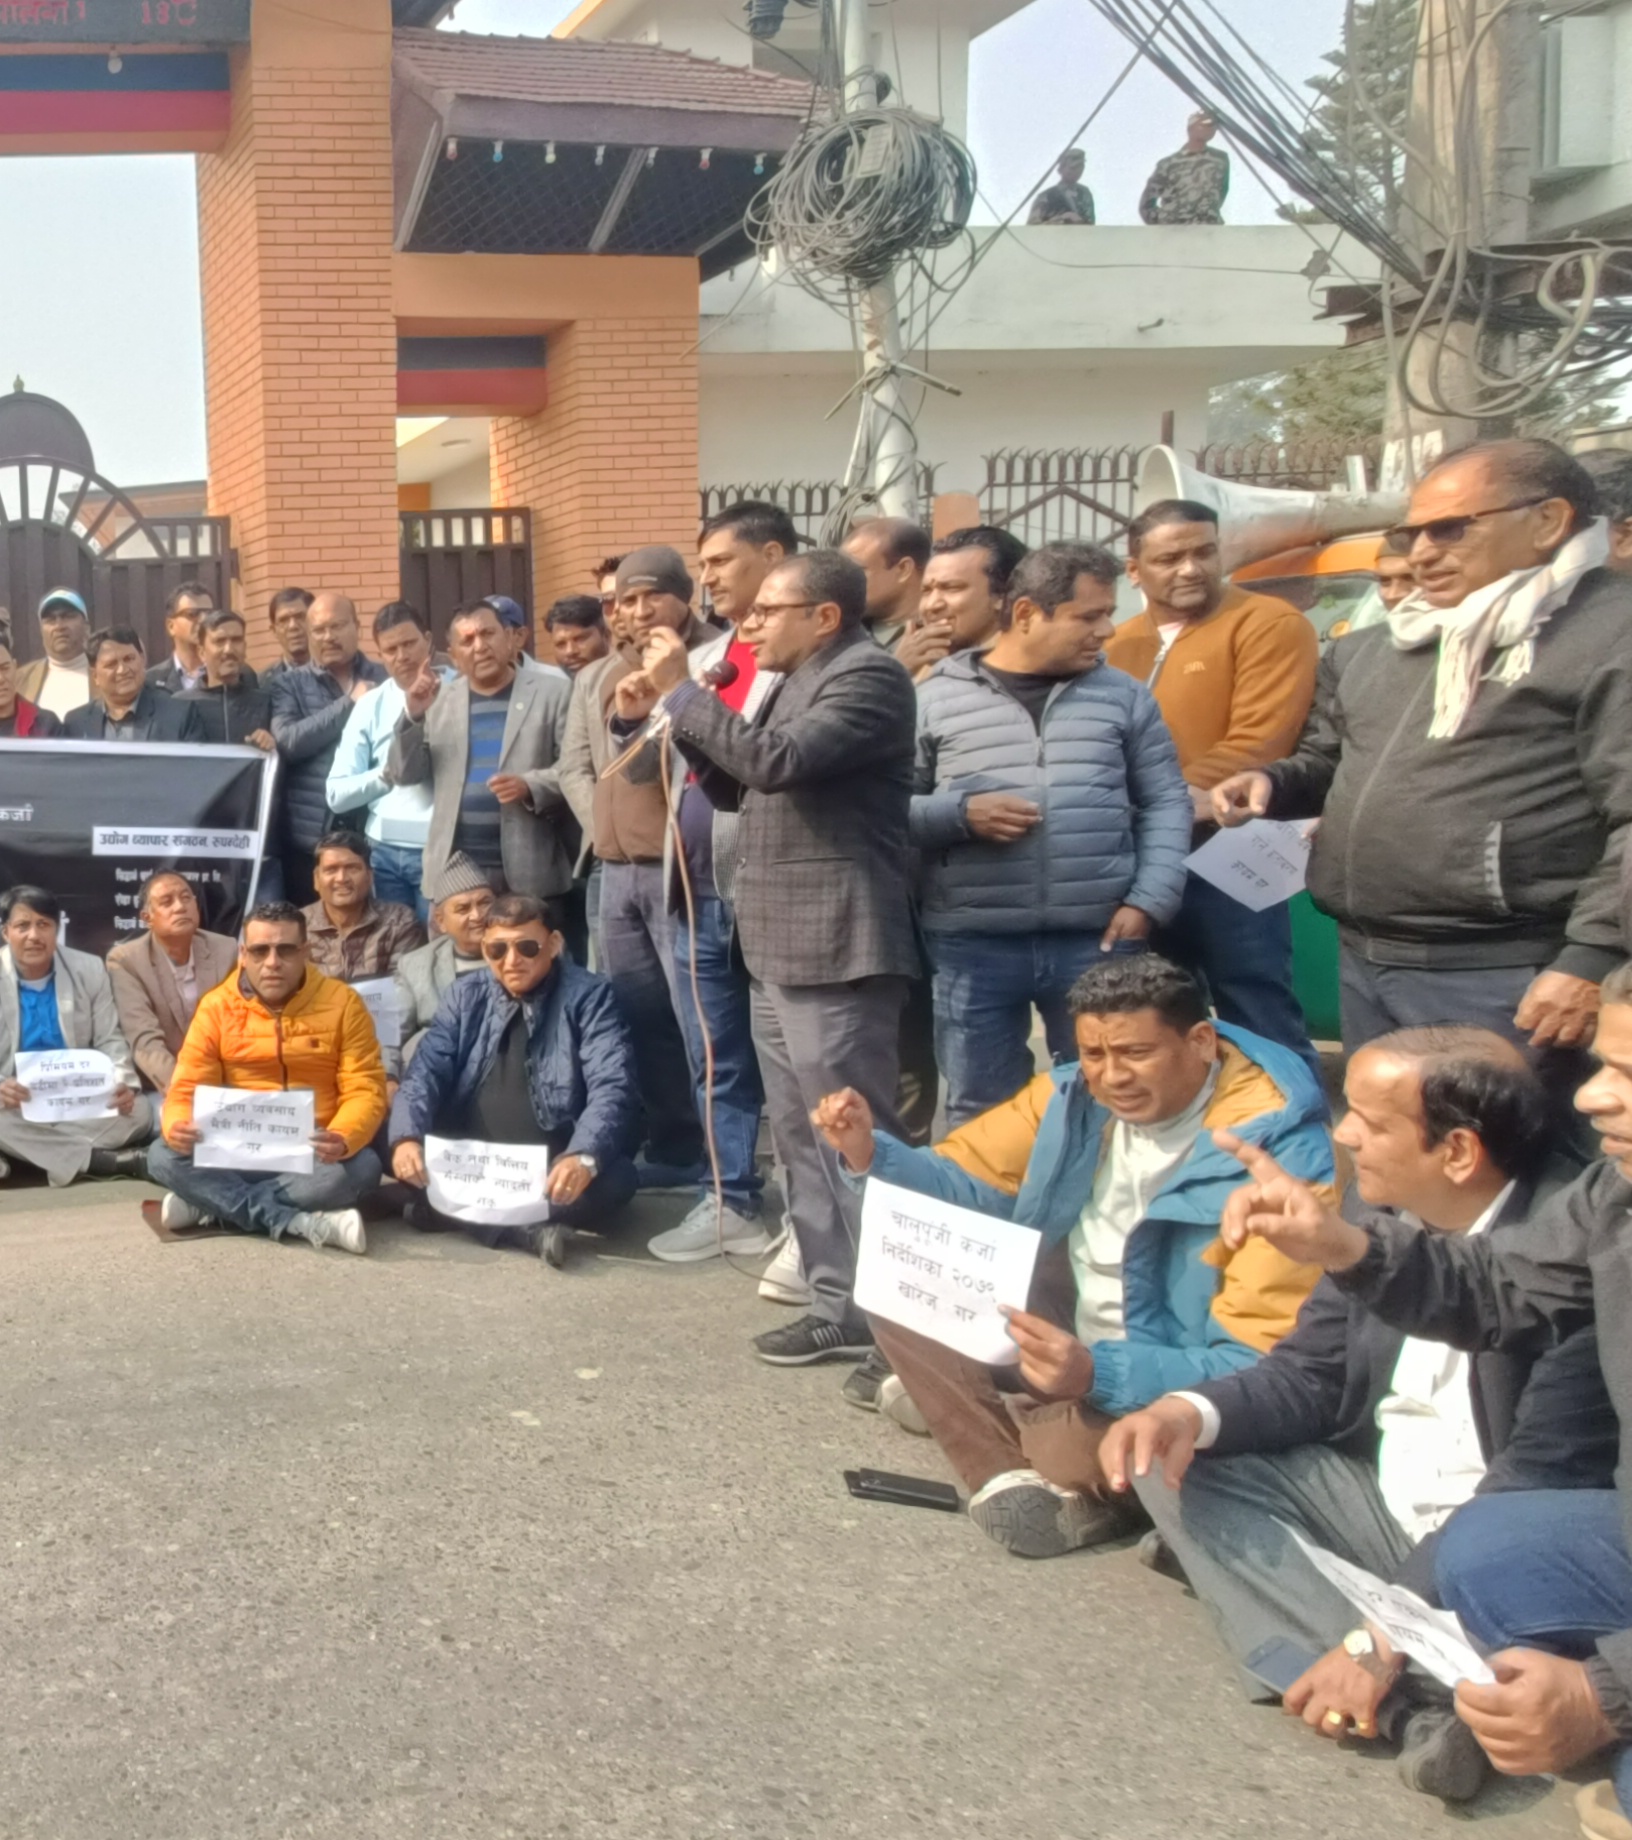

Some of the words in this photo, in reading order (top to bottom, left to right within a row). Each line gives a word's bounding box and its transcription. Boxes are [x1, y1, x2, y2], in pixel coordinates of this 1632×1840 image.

[99, 831, 129, 845] उद्योग
[132, 833, 168, 846] व्यापार
[954, 1303, 978, 1323] गर
